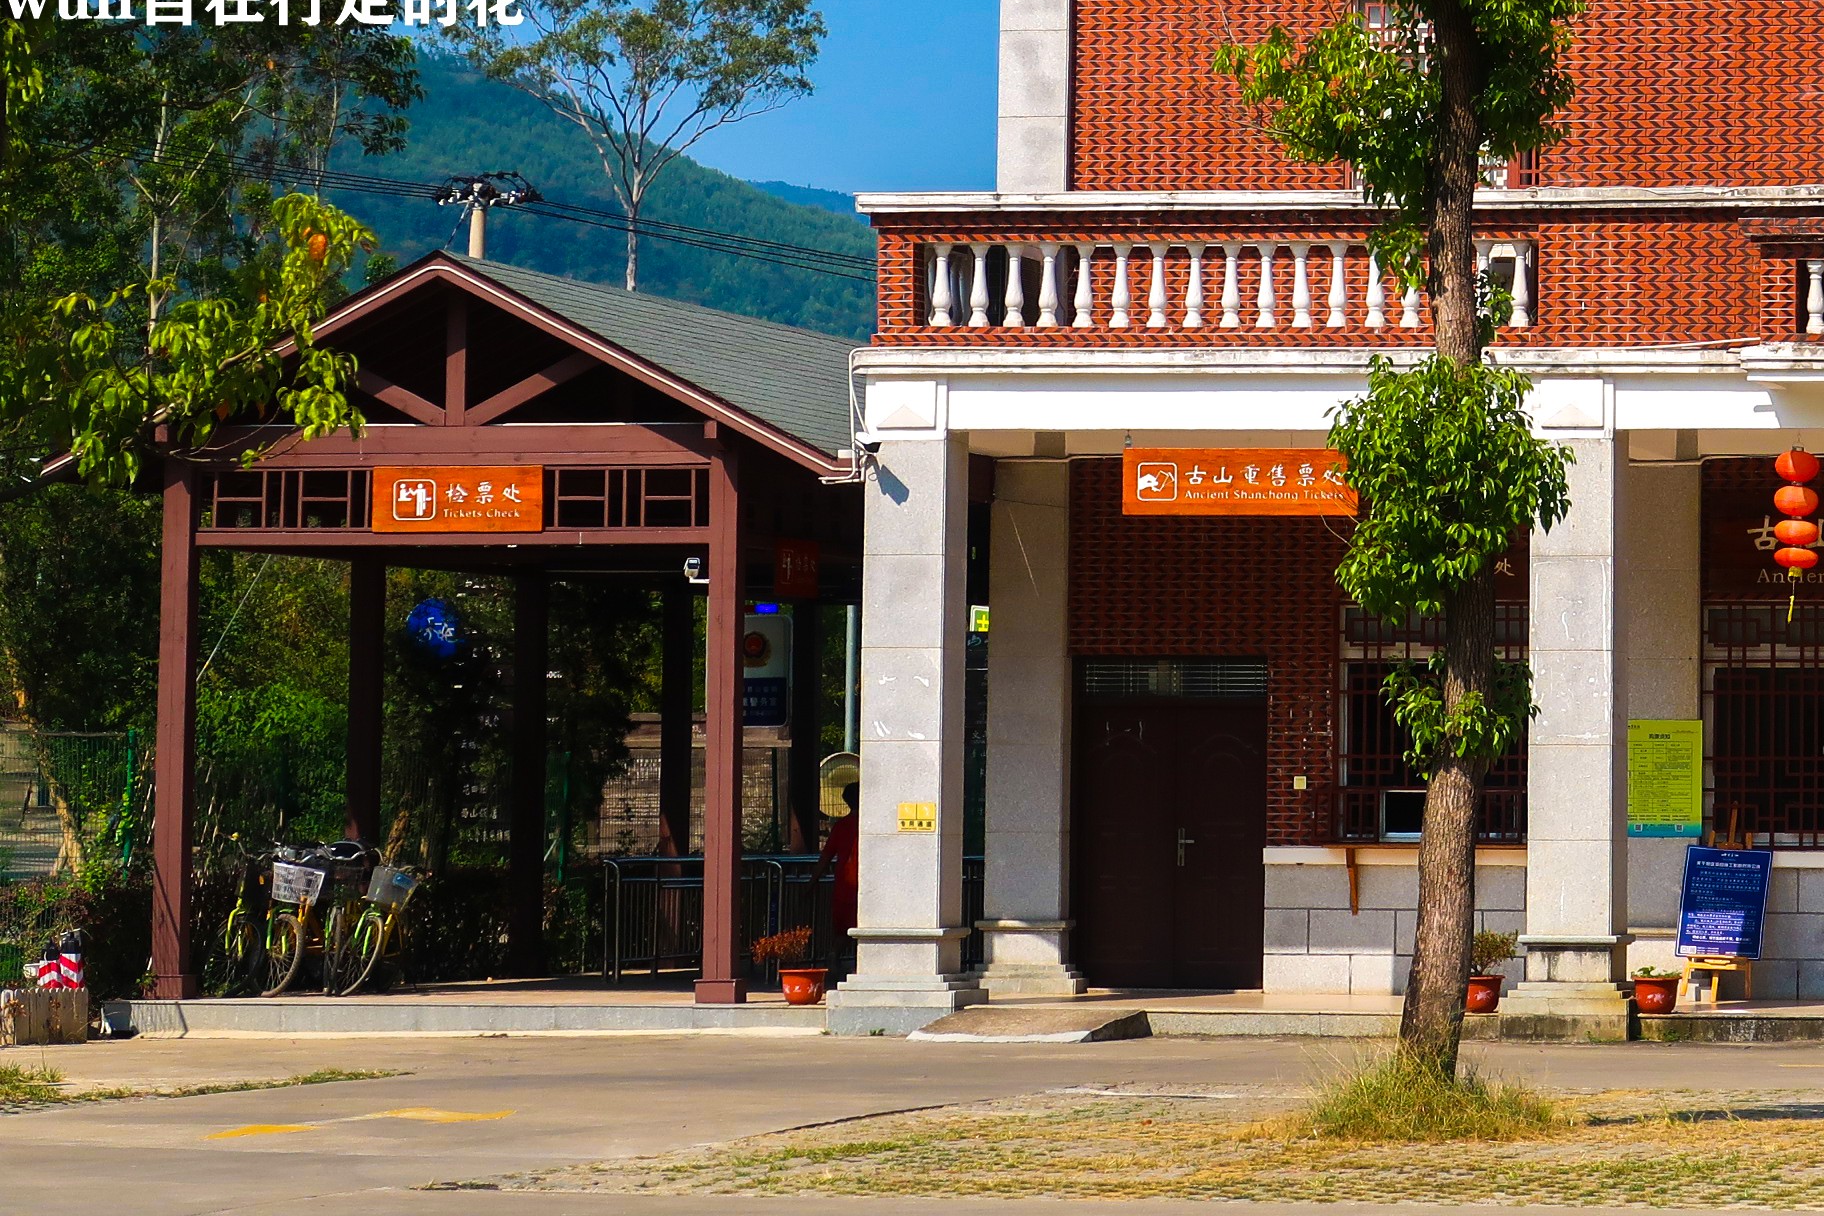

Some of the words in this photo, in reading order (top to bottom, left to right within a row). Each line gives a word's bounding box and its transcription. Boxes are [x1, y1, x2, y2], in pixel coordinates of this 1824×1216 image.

[1184, 464, 1343, 486] 古山重售票处
[445, 481, 522, 504] 检票处
[1184, 490, 1229, 499] Ancient
[1233, 490, 1299, 501] Shanchong
[1303, 490, 1344, 500] Tickets
[443, 508, 483, 518] Tickets
[486, 508, 520, 518] Check
